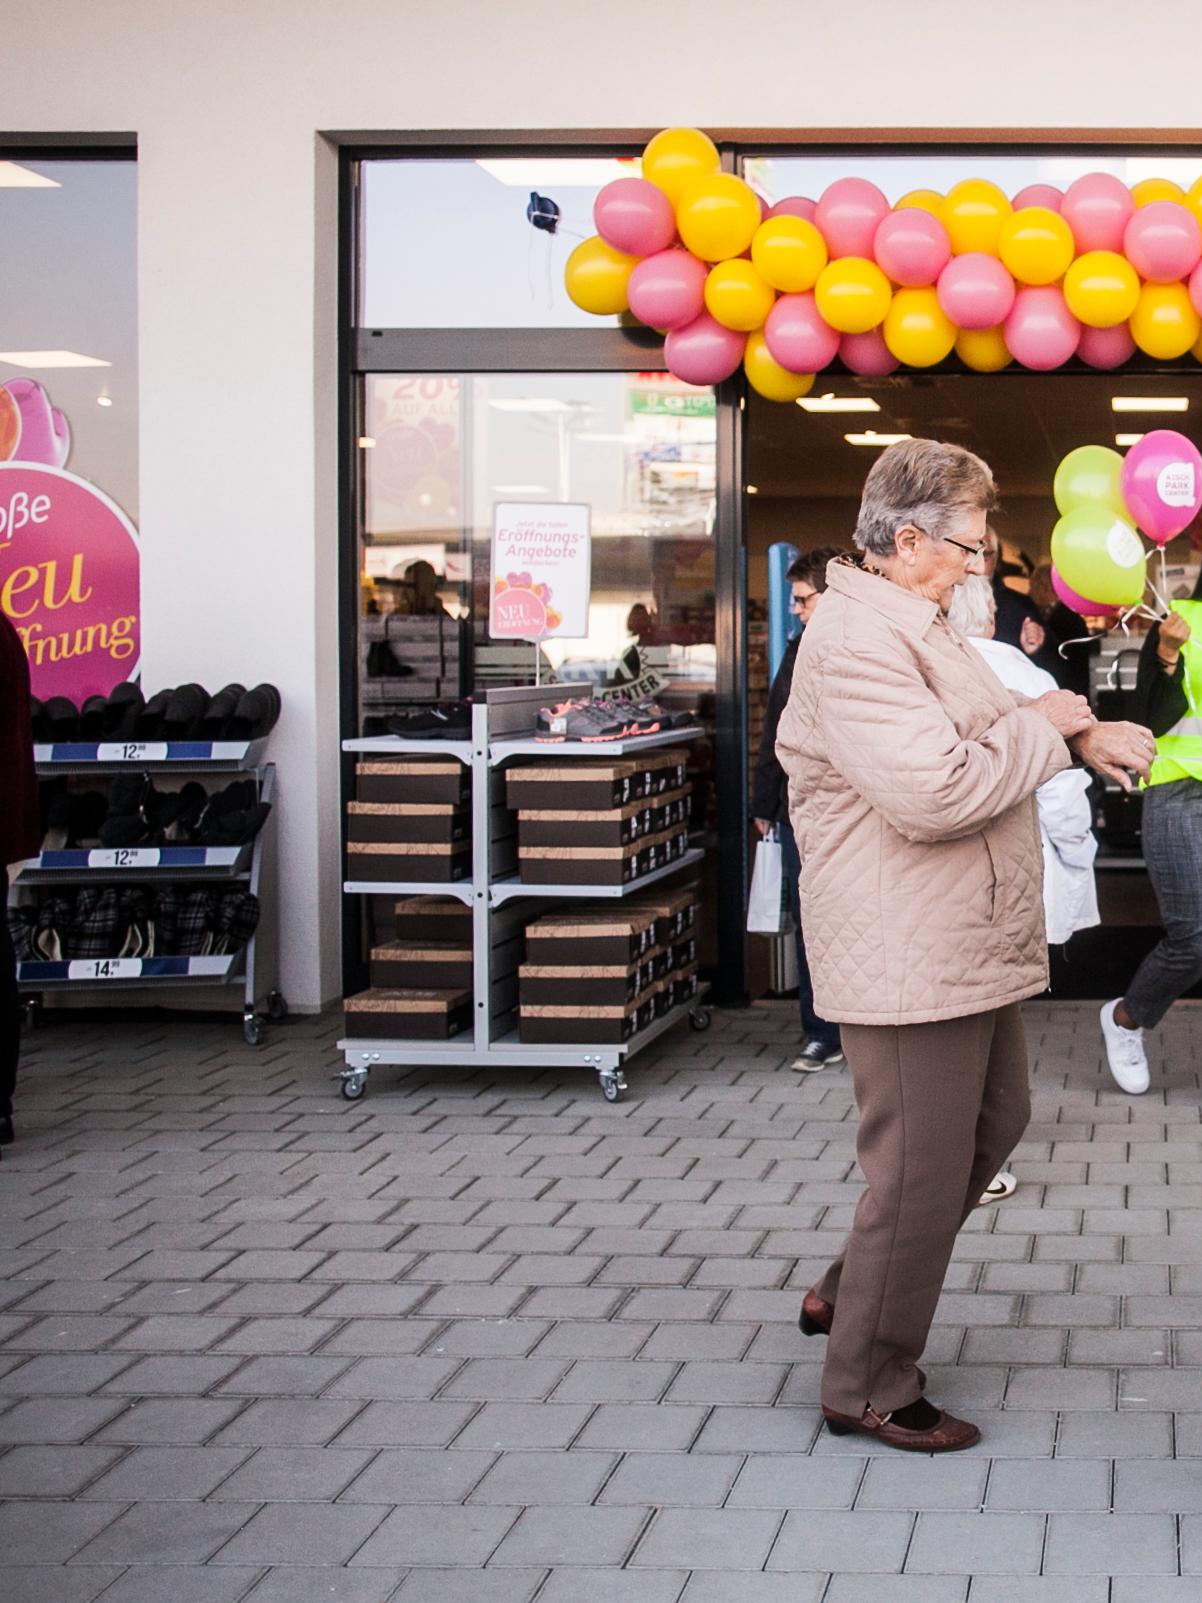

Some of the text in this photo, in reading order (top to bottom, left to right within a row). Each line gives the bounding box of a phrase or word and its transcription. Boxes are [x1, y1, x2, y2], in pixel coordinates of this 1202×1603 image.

[498, 528, 585, 545] Eröffnungs-
[505, 543, 577, 559] Angebote
[498, 603, 529, 619] NEU
[602, 674, 660, 703] CENTER
